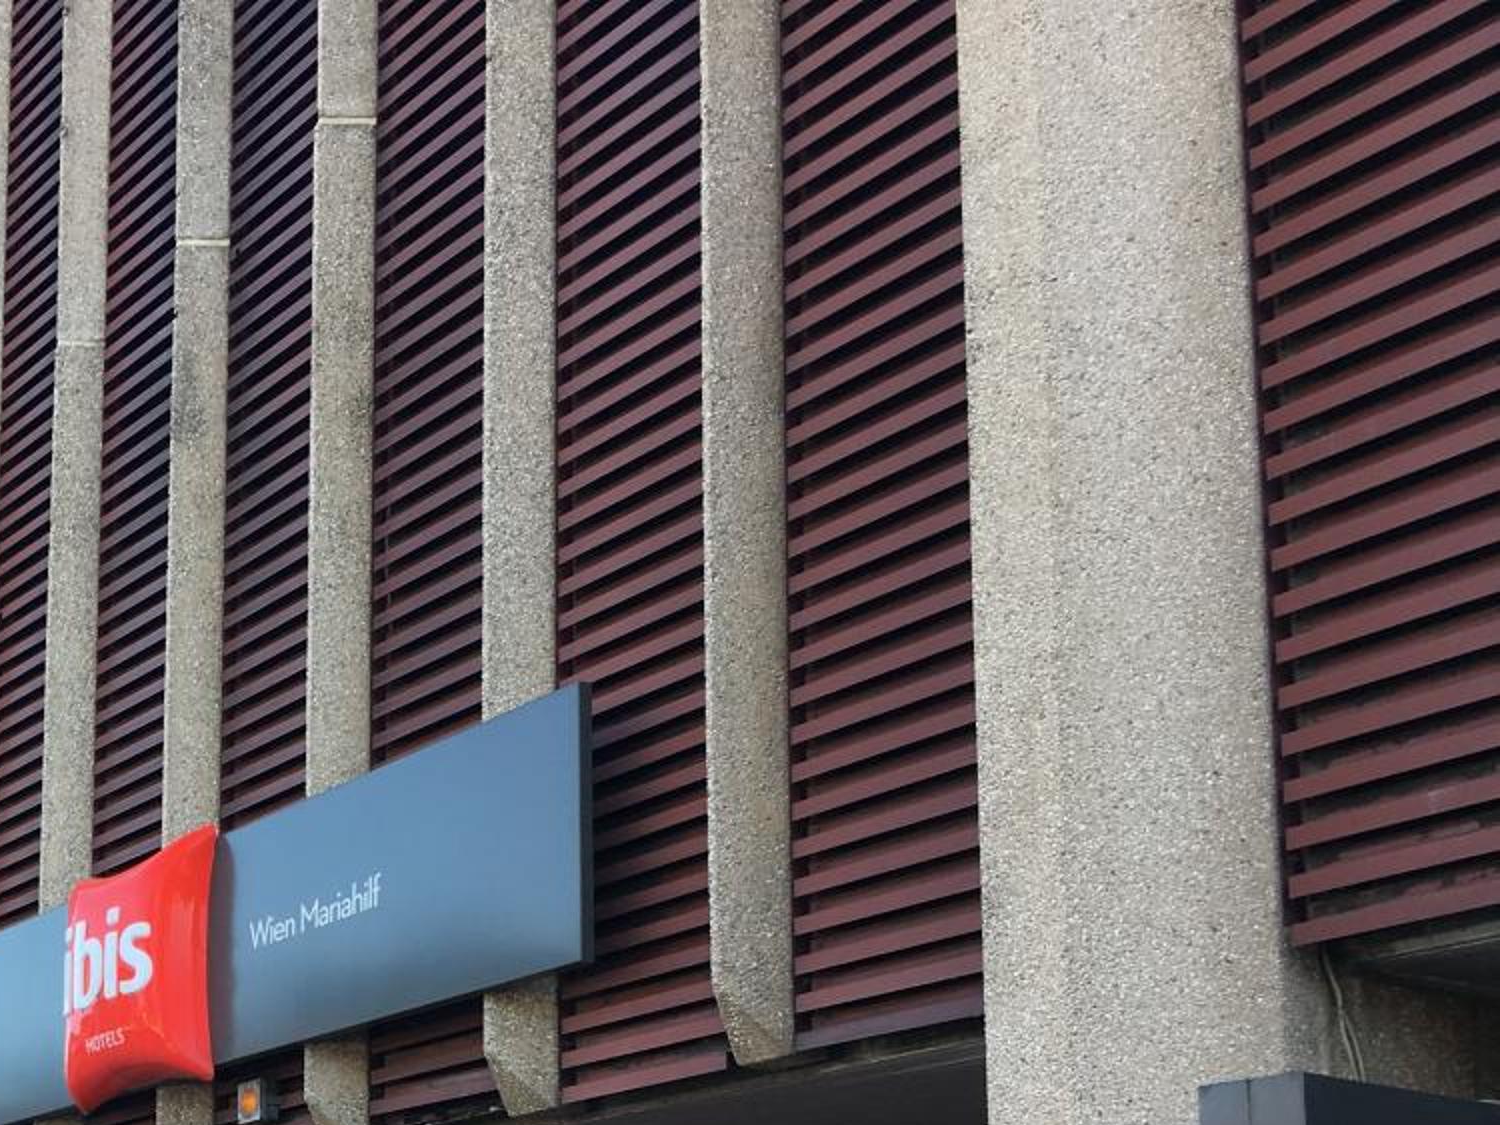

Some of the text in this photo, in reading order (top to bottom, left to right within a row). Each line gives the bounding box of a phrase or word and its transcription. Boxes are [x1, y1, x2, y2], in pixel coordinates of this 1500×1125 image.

[249, 871, 382, 950] Wien Mariahilf
[63, 906, 154, 1017] ibis
[84, 1026, 125, 1057] HOTELS
